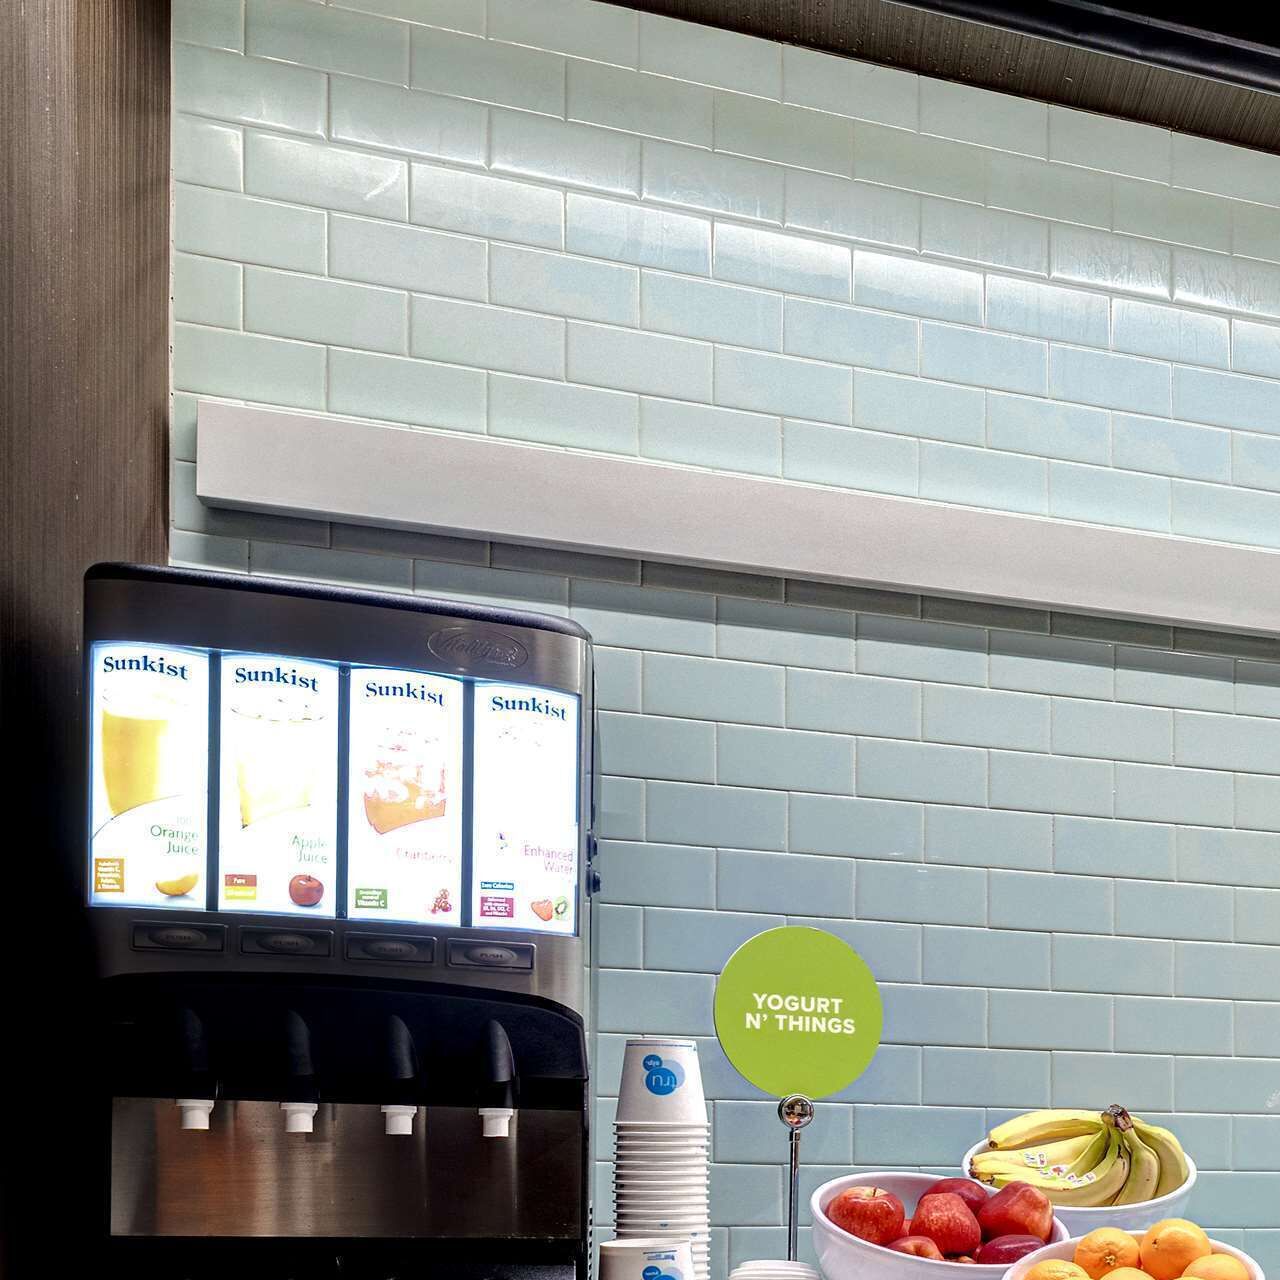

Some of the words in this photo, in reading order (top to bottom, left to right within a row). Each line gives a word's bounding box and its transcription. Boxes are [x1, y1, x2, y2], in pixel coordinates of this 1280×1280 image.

[103, 655, 189, 681] Sunkist
[235, 667, 319, 692] Sunkist
[365, 682, 445, 707] Sunkist
[492, 696, 567, 721] Sunkist
[150, 825, 199, 843] Orange
[292, 835, 328, 849] Apple
[167, 841, 199, 855] Juice
[298, 850, 328, 864] Juice
[524, 845, 574, 862] Enhanced
[544, 861, 574, 873] Water
[752, 992, 844, 1014] YOGURT
[774, 1014, 856, 1034] THINGS
